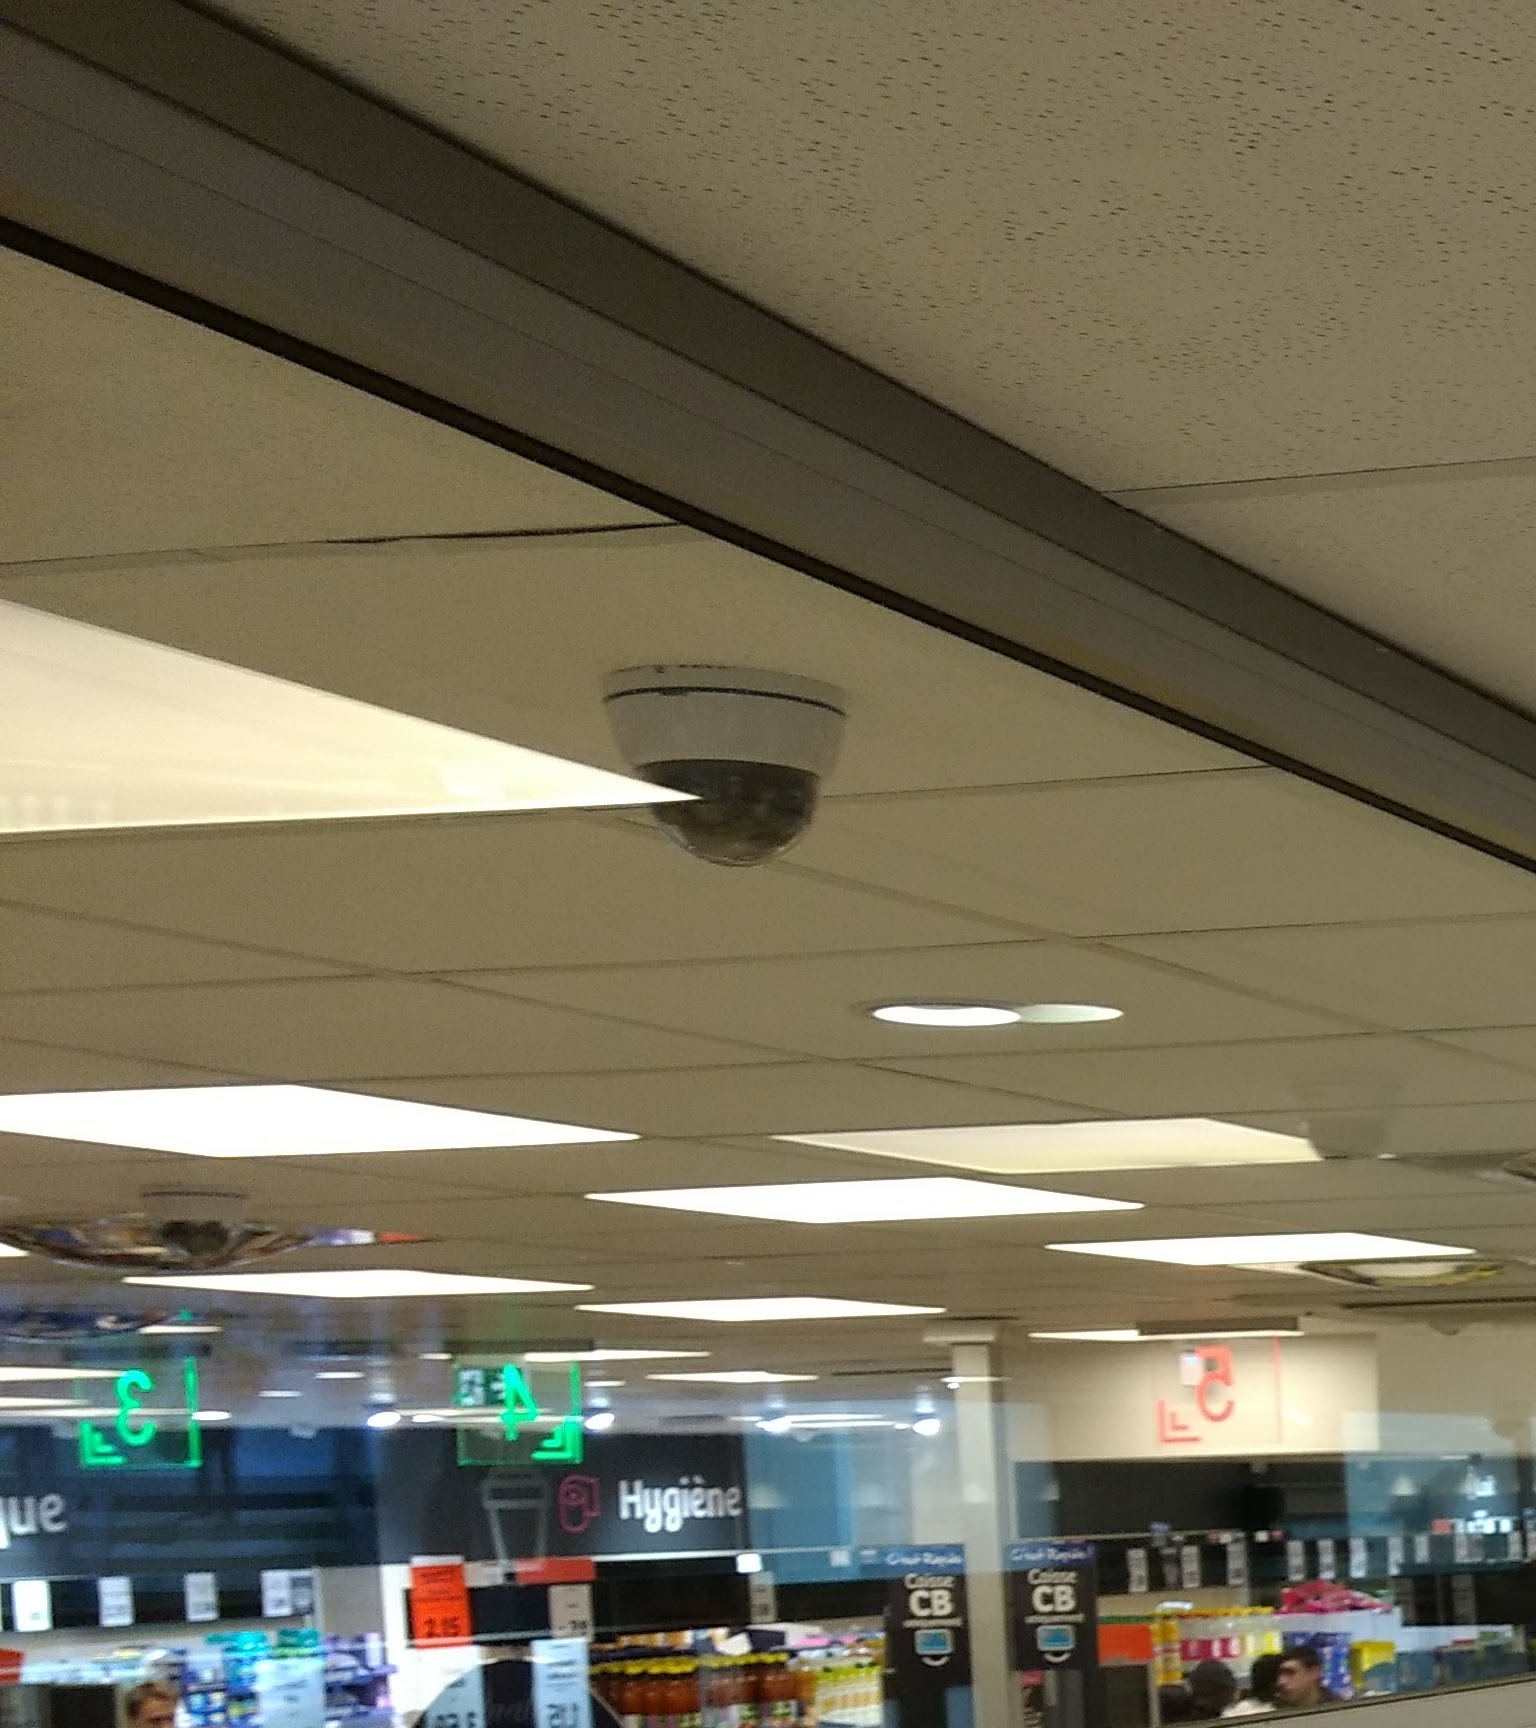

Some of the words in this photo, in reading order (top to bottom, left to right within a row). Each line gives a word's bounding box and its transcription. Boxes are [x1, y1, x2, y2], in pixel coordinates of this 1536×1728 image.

[617, 1475, 744, 1533] Hygiène
[909, 1589, 953, 1617] CB
[1031, 1584, 1077, 1614] CB
